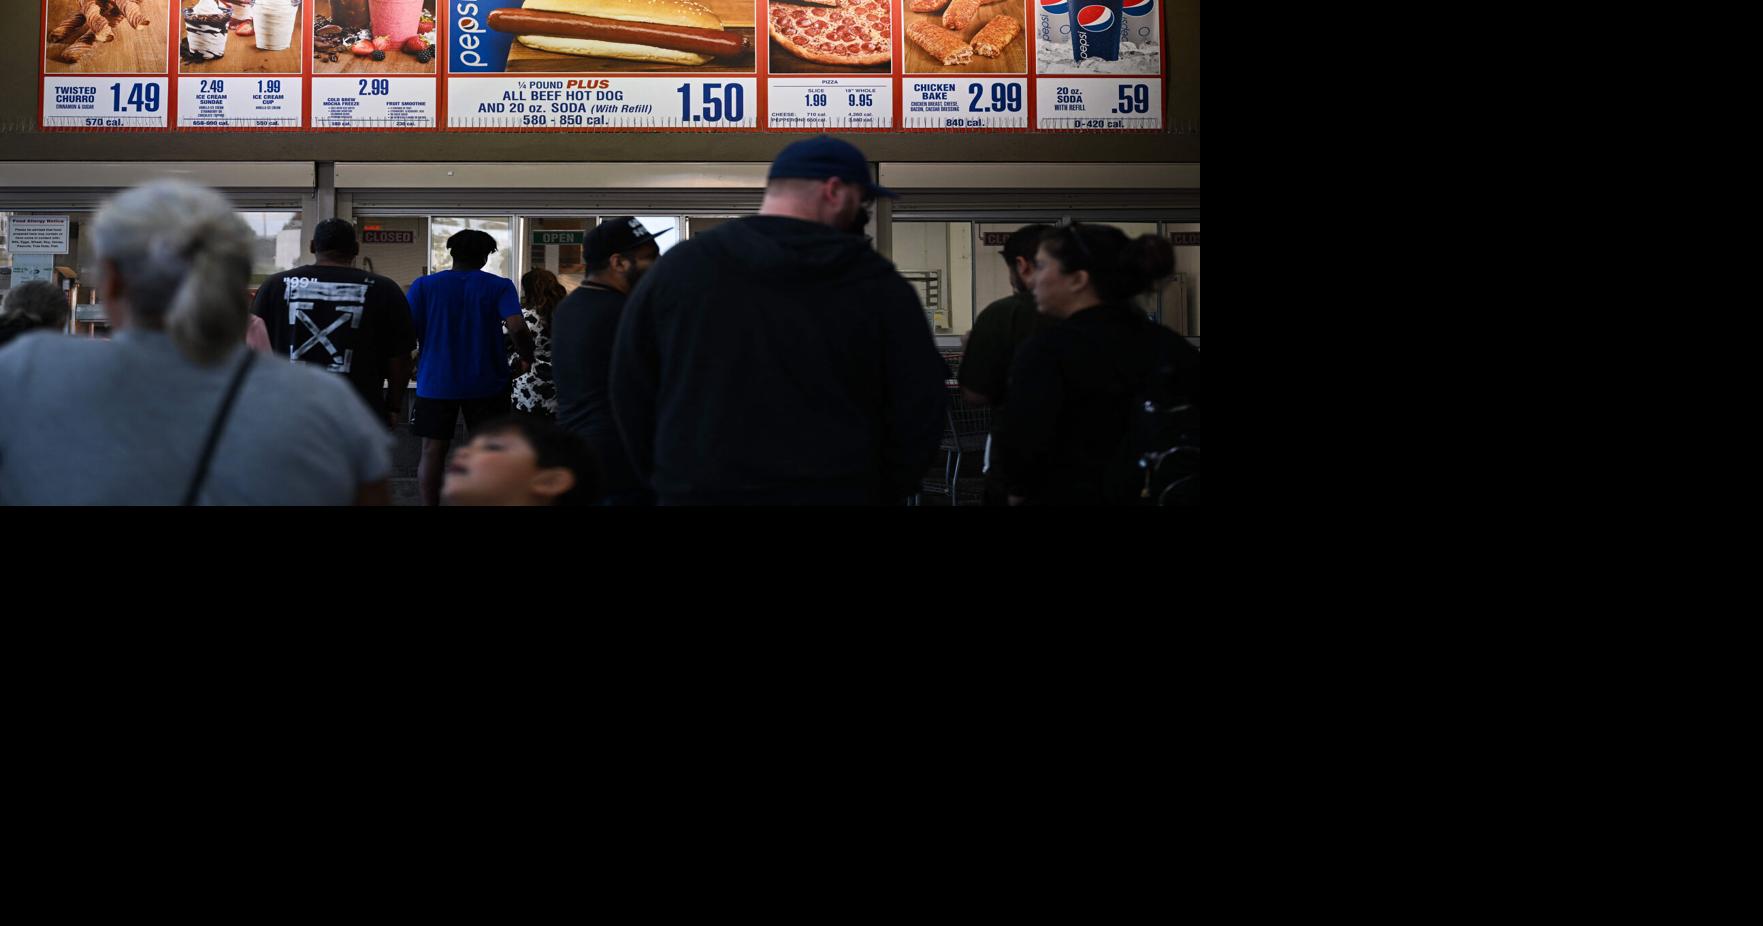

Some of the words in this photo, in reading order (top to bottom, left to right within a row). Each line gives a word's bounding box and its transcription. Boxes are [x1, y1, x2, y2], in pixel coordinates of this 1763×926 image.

[1040, 13, 1051, 42] pepsi
[1077, 30, 1090, 60] pepsi
[200, 80, 224, 93] 2.49
[258, 80, 280, 93] 1.99
[359, 79, 389, 96] 2.99
[529, 81, 563, 89] POUND
[566, 79, 610, 89] PLUS
[914, 83, 956, 92] CHICKEN
[55, 86, 96, 94] TWISTED
[503, 91, 526, 100] ALL
[531, 91, 562, 100] BEEF
[566, 91, 592, 100] HOT
[596, 91, 624, 100] DOG
[1057, 87, 1069, 95] 20
[56, 95, 95, 103] CHURRO
[110, 82, 160, 112] 1.49
[805, 94, 827, 107] 1.99
[849, 94, 873, 107] 9.95
[922, 92, 947, 100] BAKE
[968, 82, 1022, 112] 2.99
[1057, 95, 1083, 103] SODA
[1112, 84, 1149, 113] .59
[677, 82, 744, 122] 1.50
[478, 103, 505, 113] AND
[509, 103, 524, 113] 20
[529, 105, 546, 113] oz.
[551, 103, 586, 113] SODA
[591, 104, 618, 115] (With
[620, 104, 652, 115] Refill)
[86, 118, 103, 126] 570
[106, 118, 124, 126] cal.
[523, 115, 546, 125] 580
[559, 115, 582, 125] 850
[586, 115, 609, 125] cal.
[1107, 120, 1124, 128] cal.
[365, 231, 411, 242] CLOSED
[543, 233, 574, 243] OPEN
